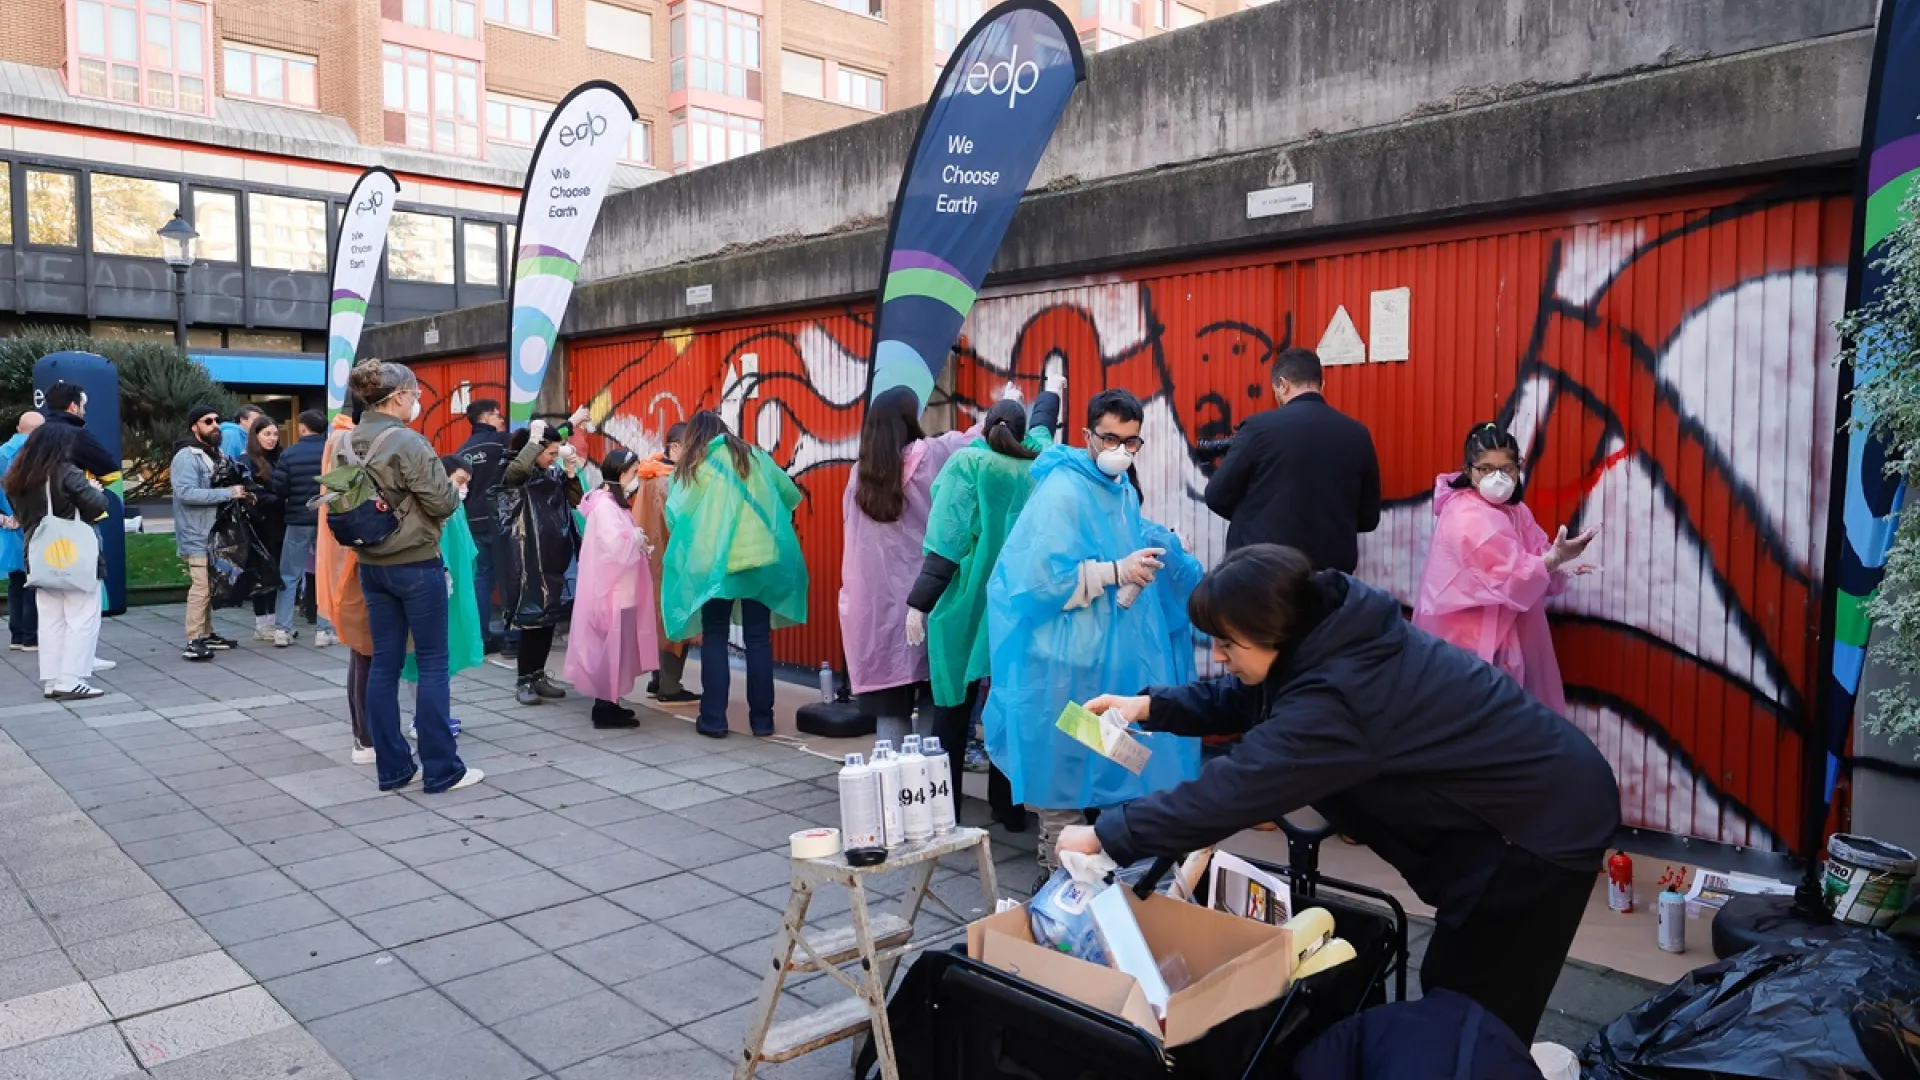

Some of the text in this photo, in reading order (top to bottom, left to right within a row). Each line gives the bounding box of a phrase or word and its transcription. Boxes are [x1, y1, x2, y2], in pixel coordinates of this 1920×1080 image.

[966, 44, 1039, 109] edp
[559, 111, 607, 146] edp
[949, 135, 973, 153] We
[551, 167, 570, 180] We
[942, 165, 1000, 185] Choose
[550, 186, 591, 200] Choose
[549, 205, 578, 218] Earth
[936, 194, 978, 214] Earth
